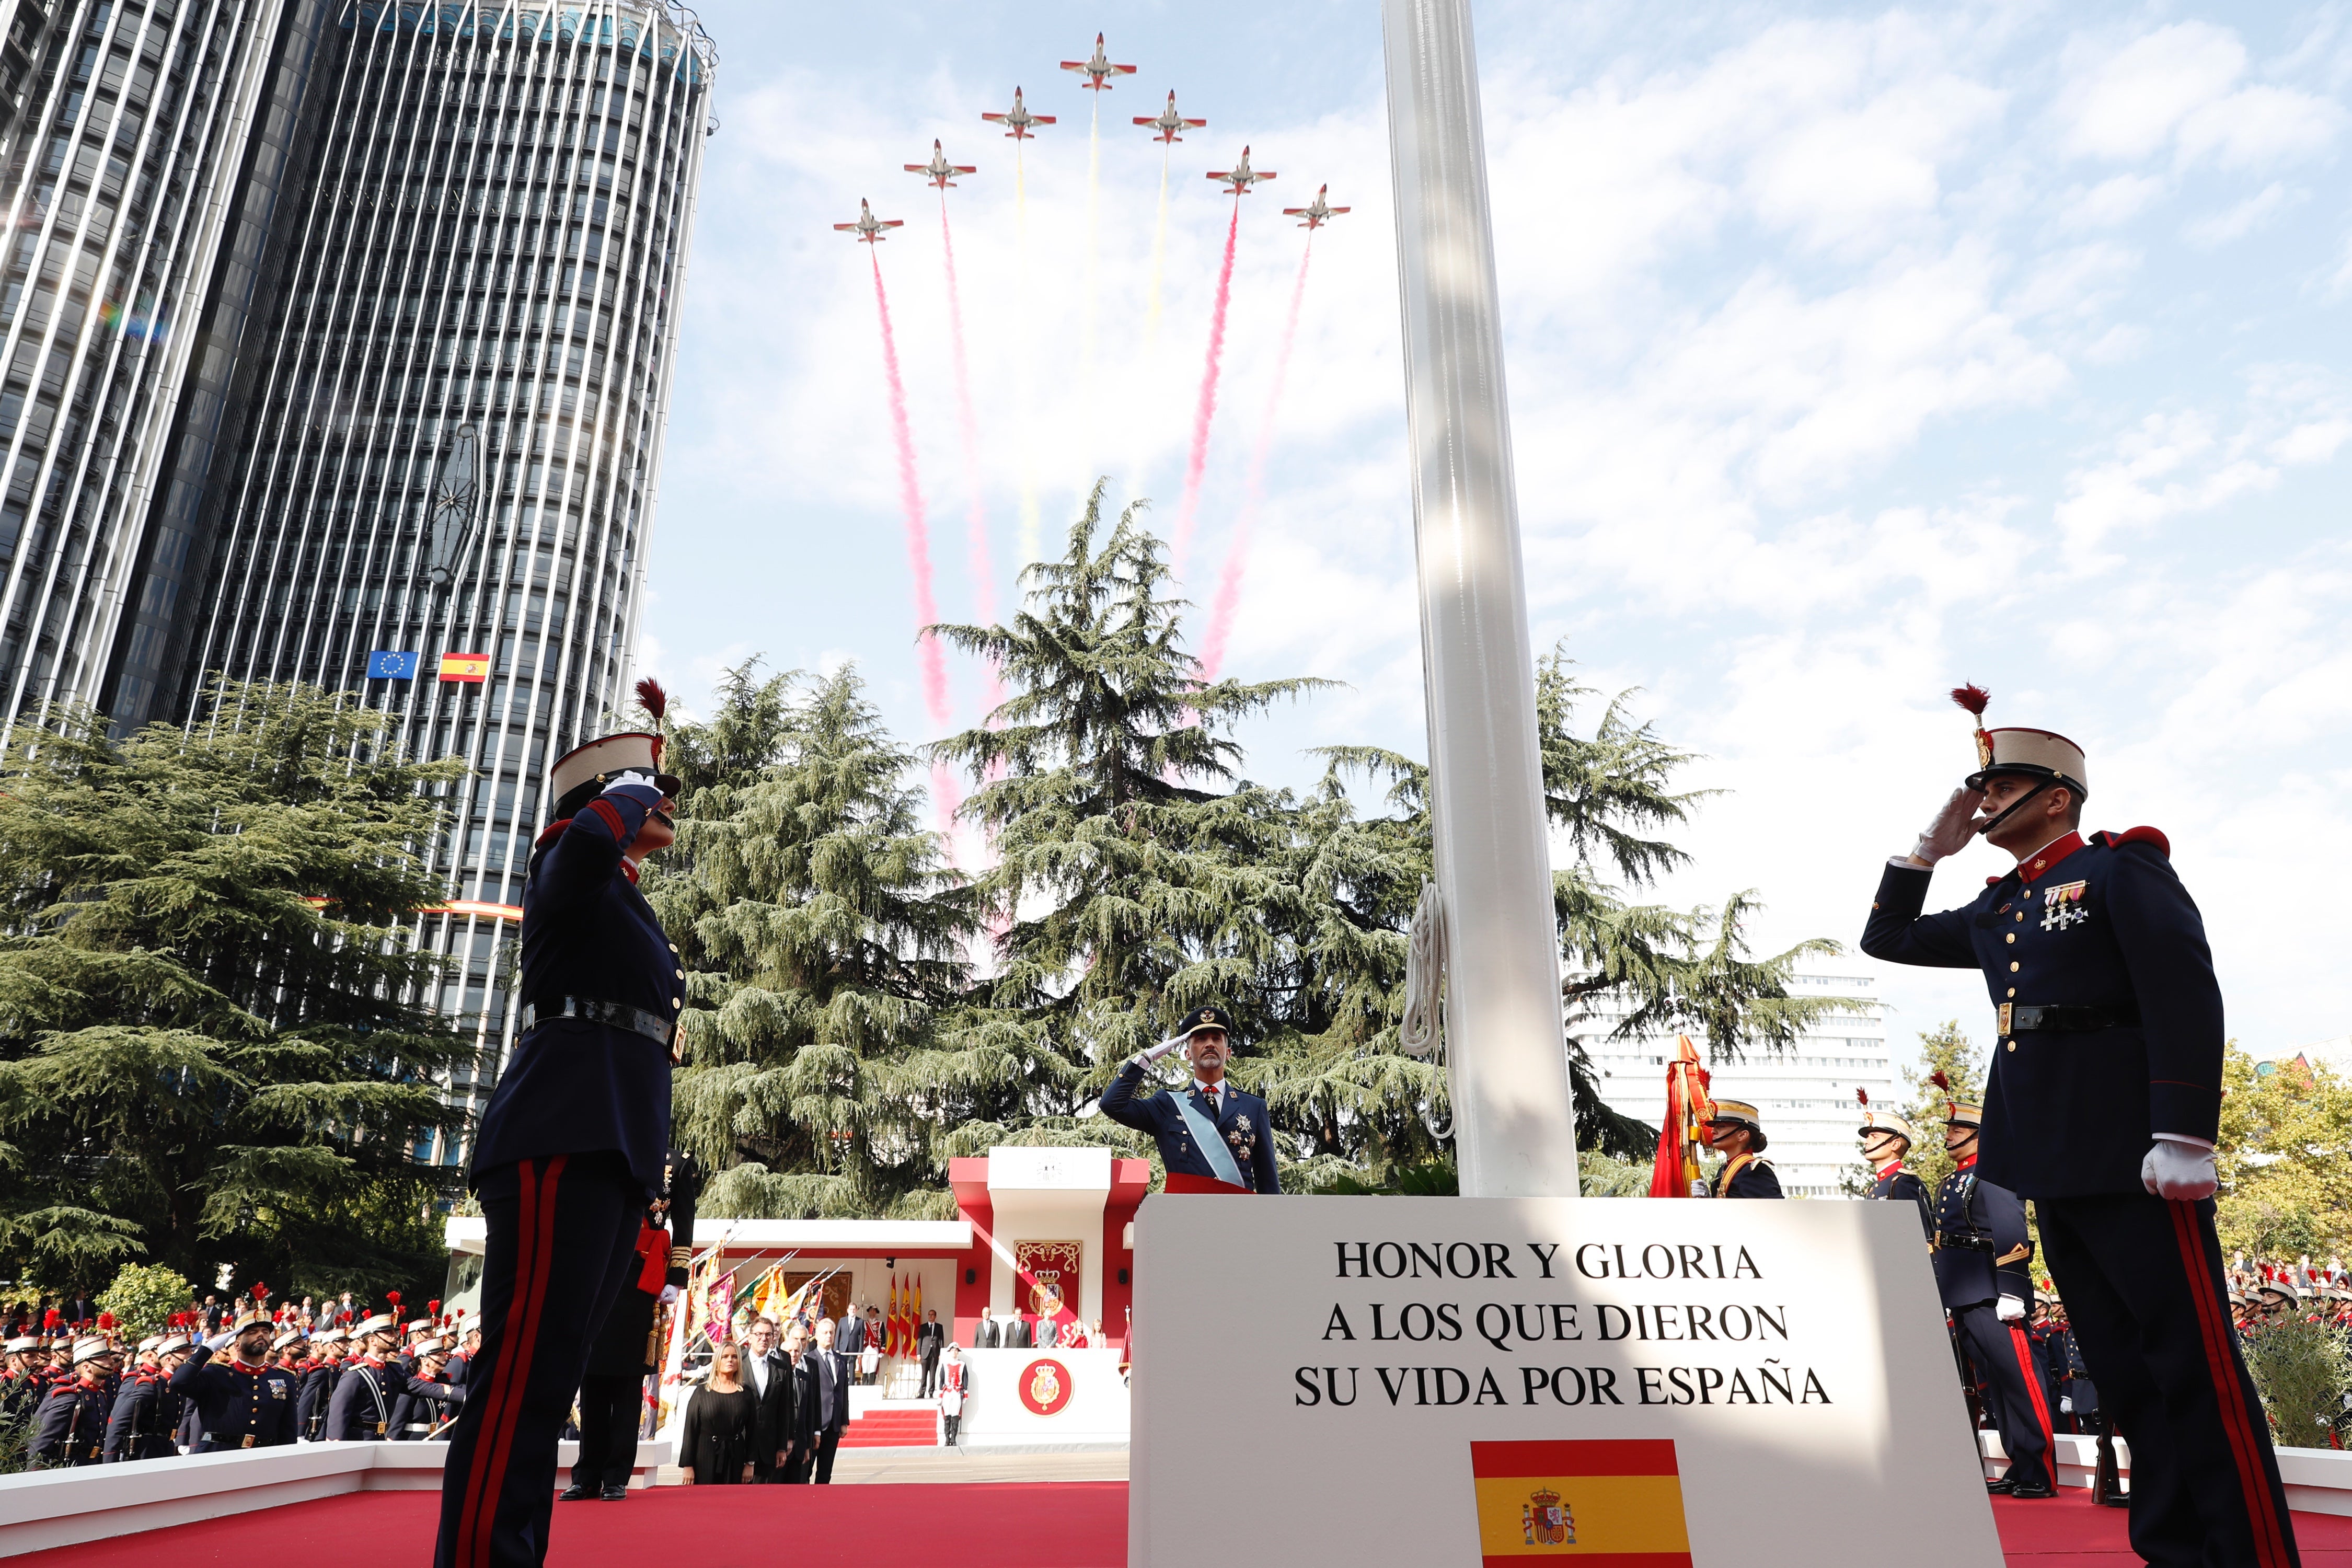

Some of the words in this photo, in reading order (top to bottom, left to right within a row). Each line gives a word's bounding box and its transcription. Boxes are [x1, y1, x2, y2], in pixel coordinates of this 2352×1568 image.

[1334, 1242, 1517, 1278] HONOR
[1527, 1243, 1560, 1278] Y
[1576, 1244, 1762, 1278] GLORIA
[1322, 1303, 1357, 1340] A
[1369, 1304, 1462, 1341] LOS
[1477, 1304, 1582, 1352] QUE
[1593, 1305, 1788, 1341] DIERON
[1295, 1367, 1359, 1406] SU
[1375, 1367, 1508, 1406] VIDA
[1519, 1367, 1624, 1405] POR
[1633, 1358, 1833, 1405] ESPAÑA
